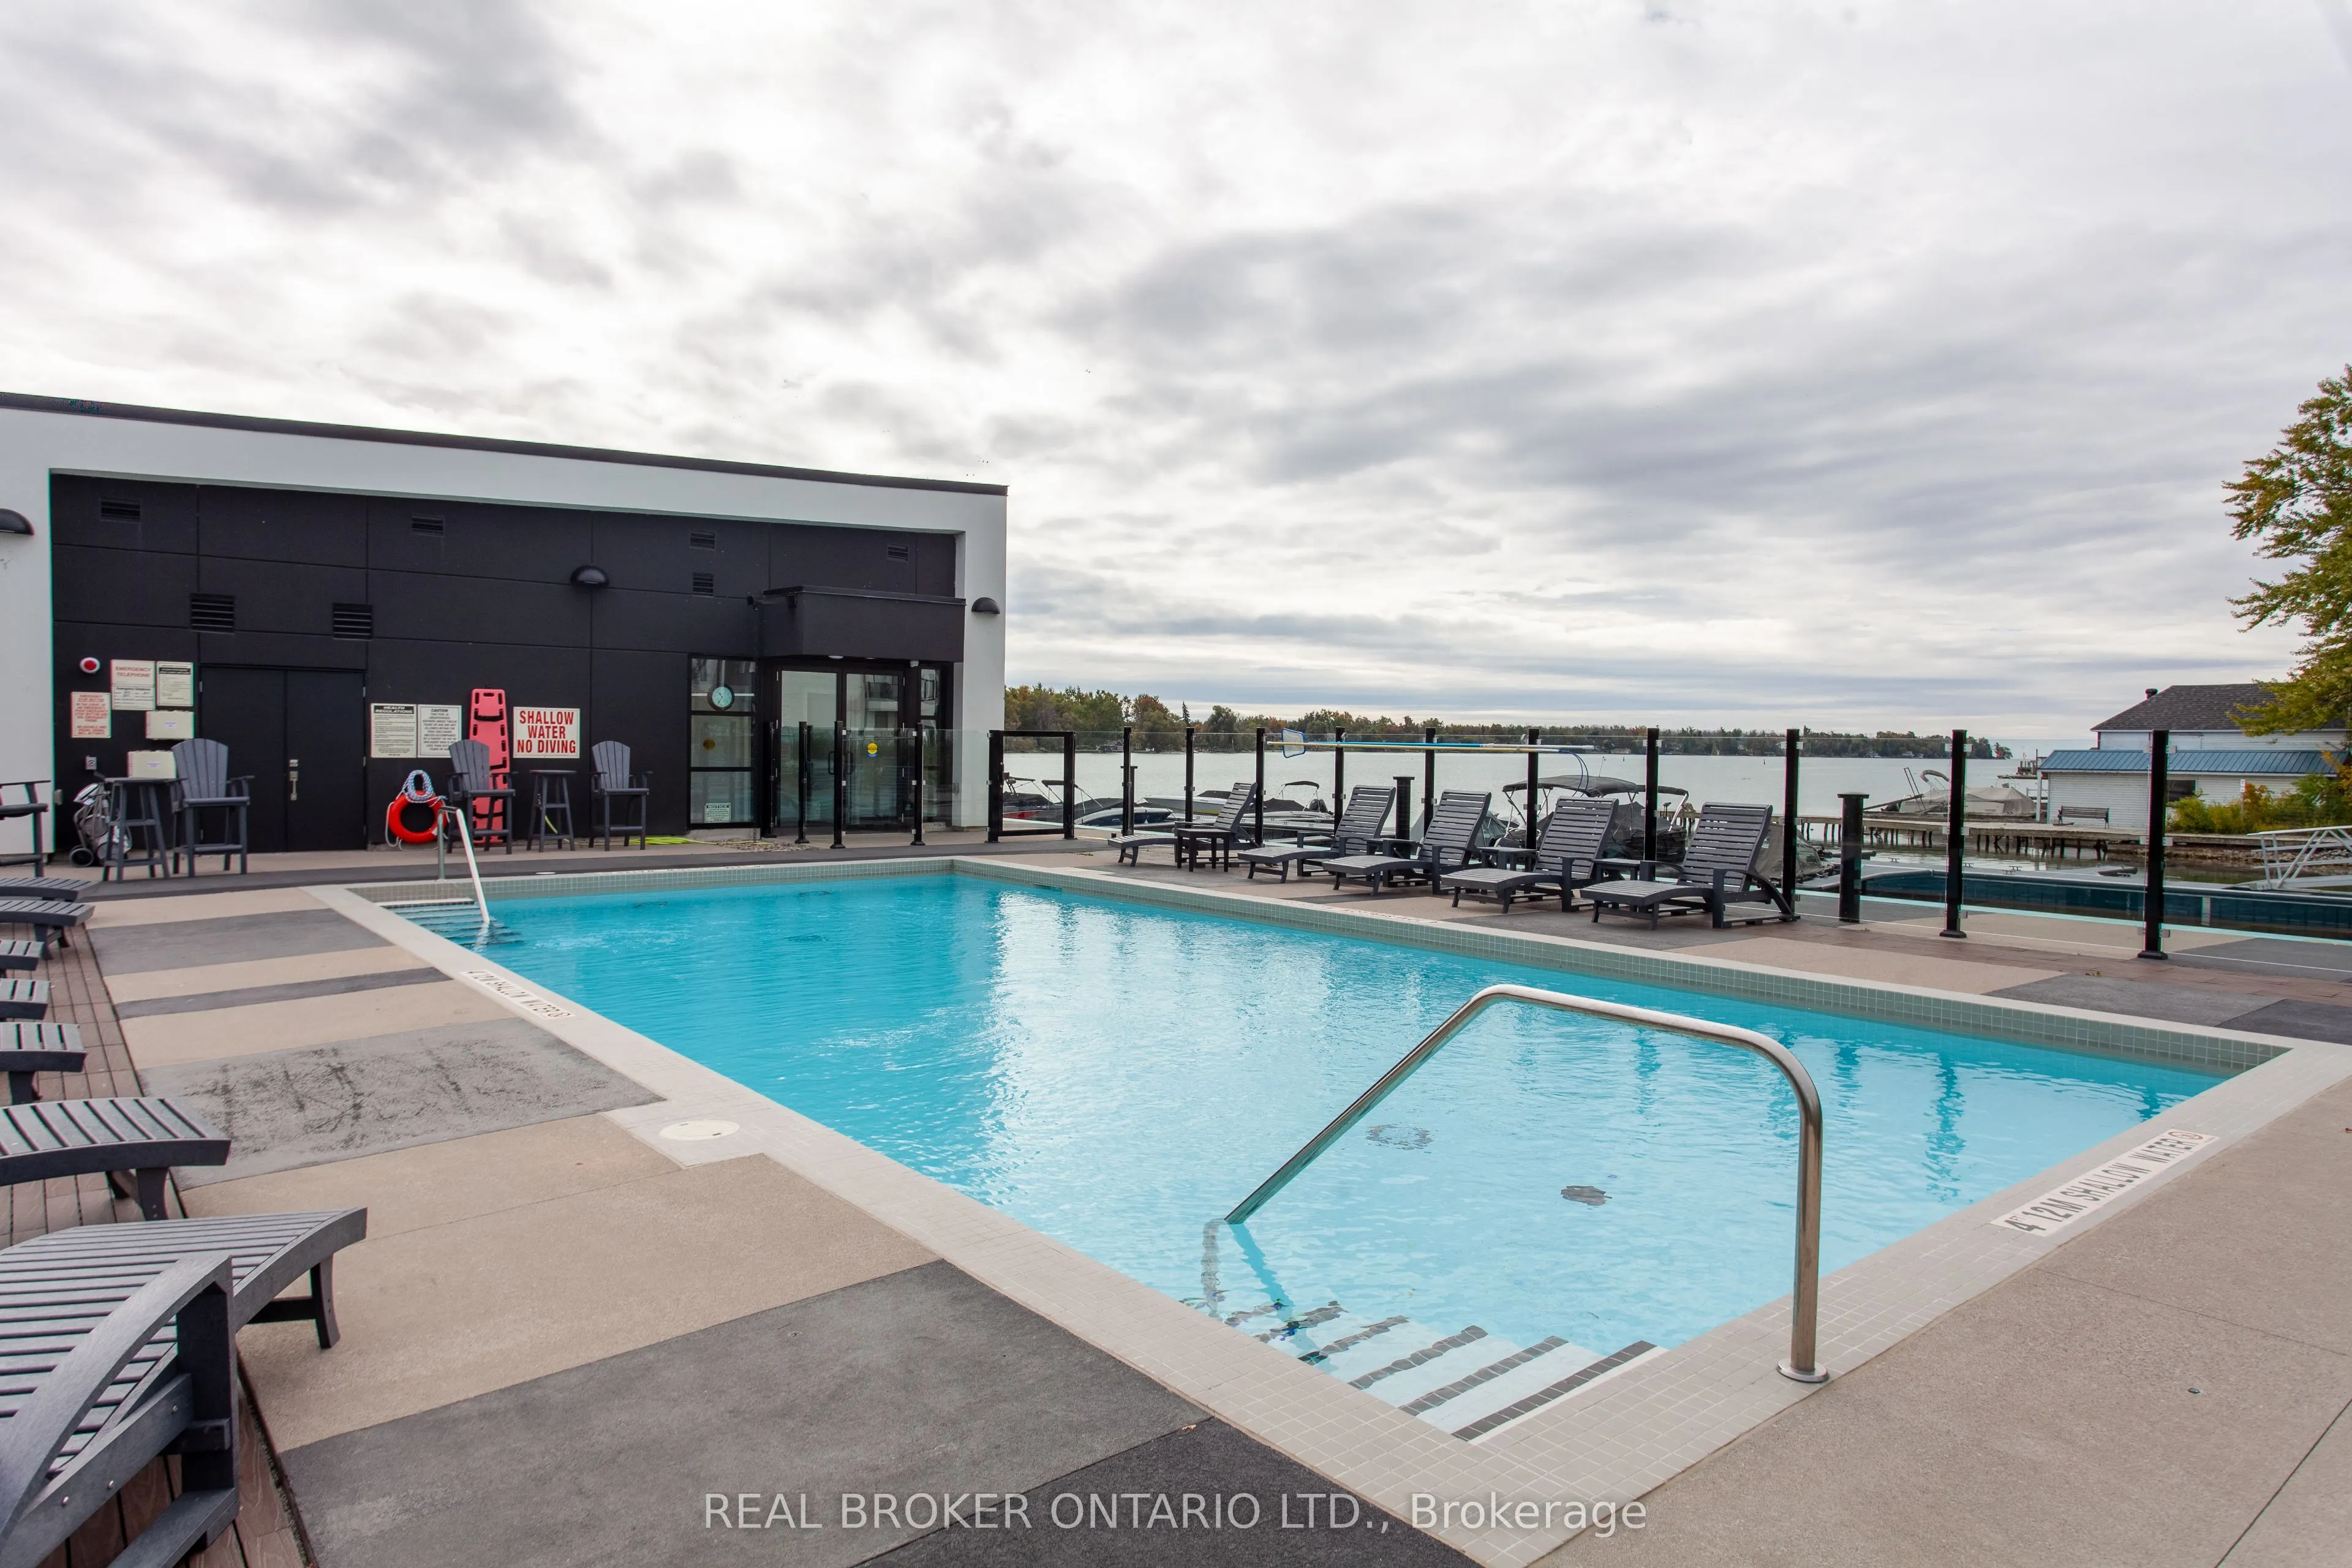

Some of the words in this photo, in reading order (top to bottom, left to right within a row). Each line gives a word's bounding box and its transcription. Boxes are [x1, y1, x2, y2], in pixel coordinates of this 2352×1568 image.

[519, 710, 574, 725] SHALLOW
[527, 725, 565, 739] WATER
[517, 739, 532, 753] NO
[538, 740, 576, 753] DIVING
[2059, 1162, 2152, 1202] SHALLOW
[2128, 1137, 2199, 1164] WATER
